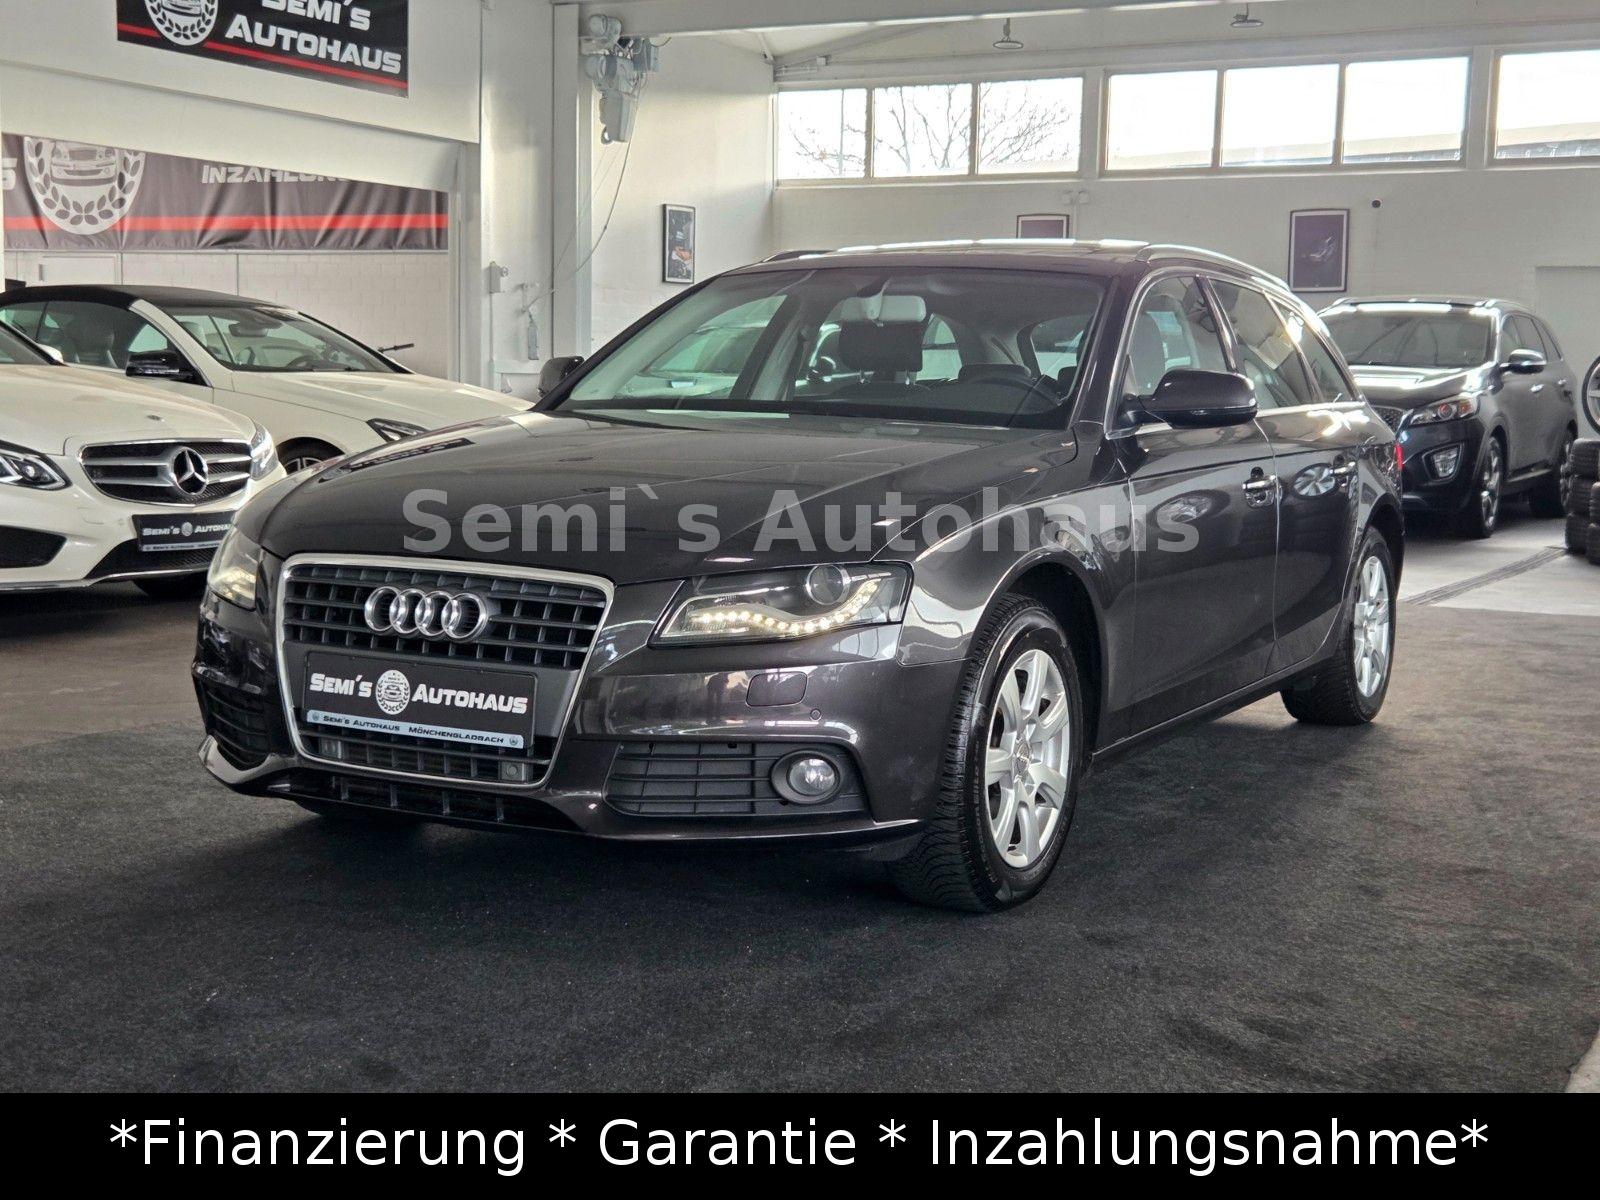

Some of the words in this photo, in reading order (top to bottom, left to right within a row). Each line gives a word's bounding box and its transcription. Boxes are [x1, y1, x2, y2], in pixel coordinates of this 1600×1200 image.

[225, 13, 401, 75] AUTOHAUS
[202, 165, 350, 184] INZAHL
[411, 683, 528, 715] AUTOHAUS
[353, 719, 400, 731] AUTOHAUS
[408, 726, 504, 744] MÖNCHENGLADBACH
